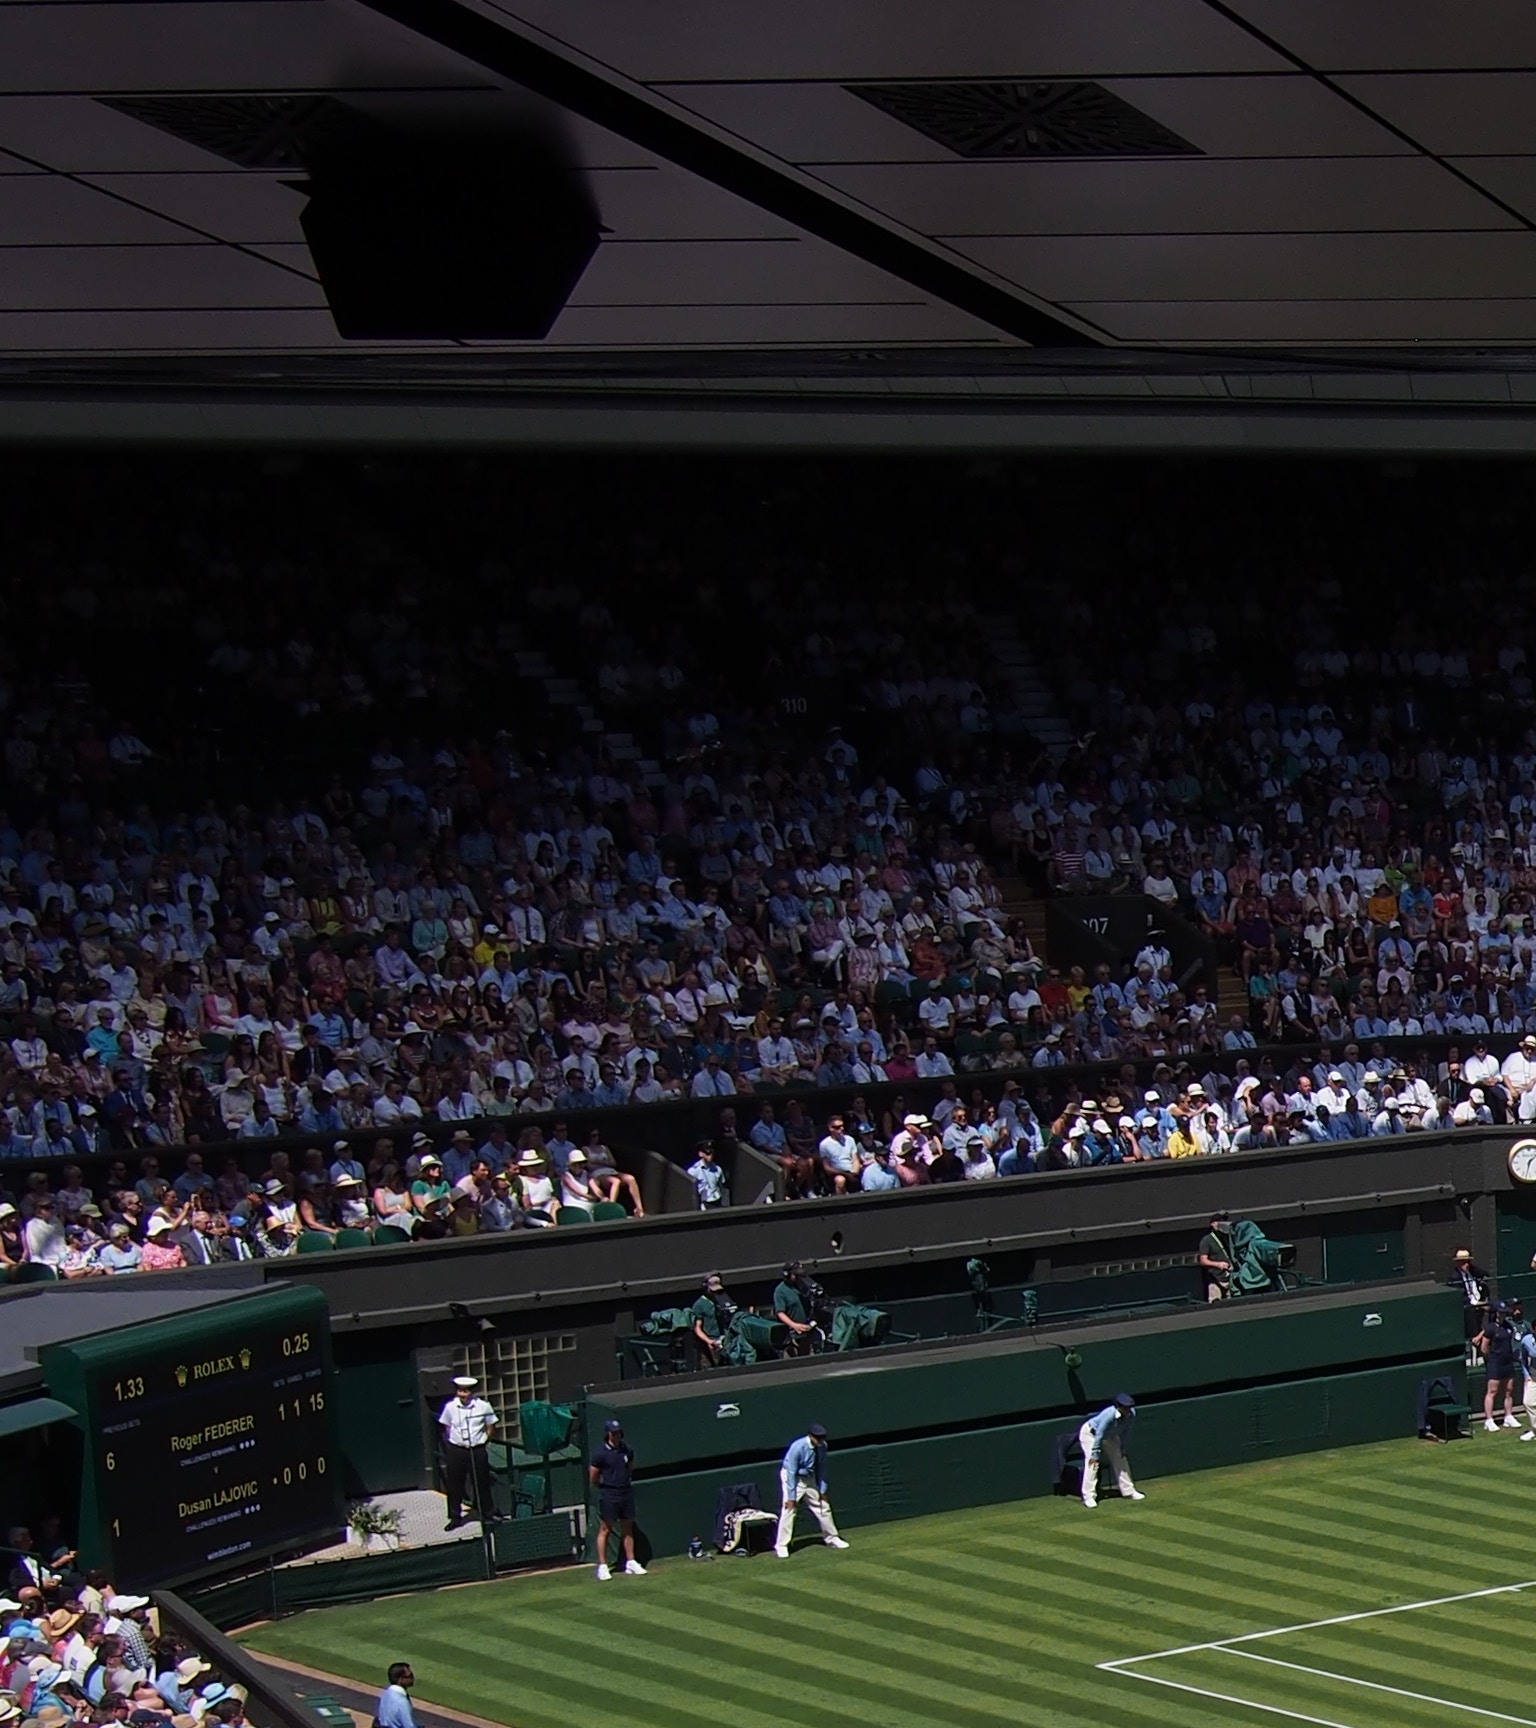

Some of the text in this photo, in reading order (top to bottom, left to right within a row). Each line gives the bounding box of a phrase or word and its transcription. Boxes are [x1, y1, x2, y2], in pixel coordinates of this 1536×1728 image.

[1082, 917, 1109, 934] 07
[282, 1333, 310, 1357] 0.25
[193, 1356, 235, 1379] ROLEX
[114, 1377, 145, 1401] 1.33
[278, 1393, 324, 1421] 1 1 15
[171, 1415, 255, 1452] Roger FEDERER
[106, 1452, 116, 1471] 6
[283, 1457, 325, 1485] 0 0 0
[178, 1481, 258, 1518] Dusan LAJOVIC
[112, 1519, 121, 1538] 1
